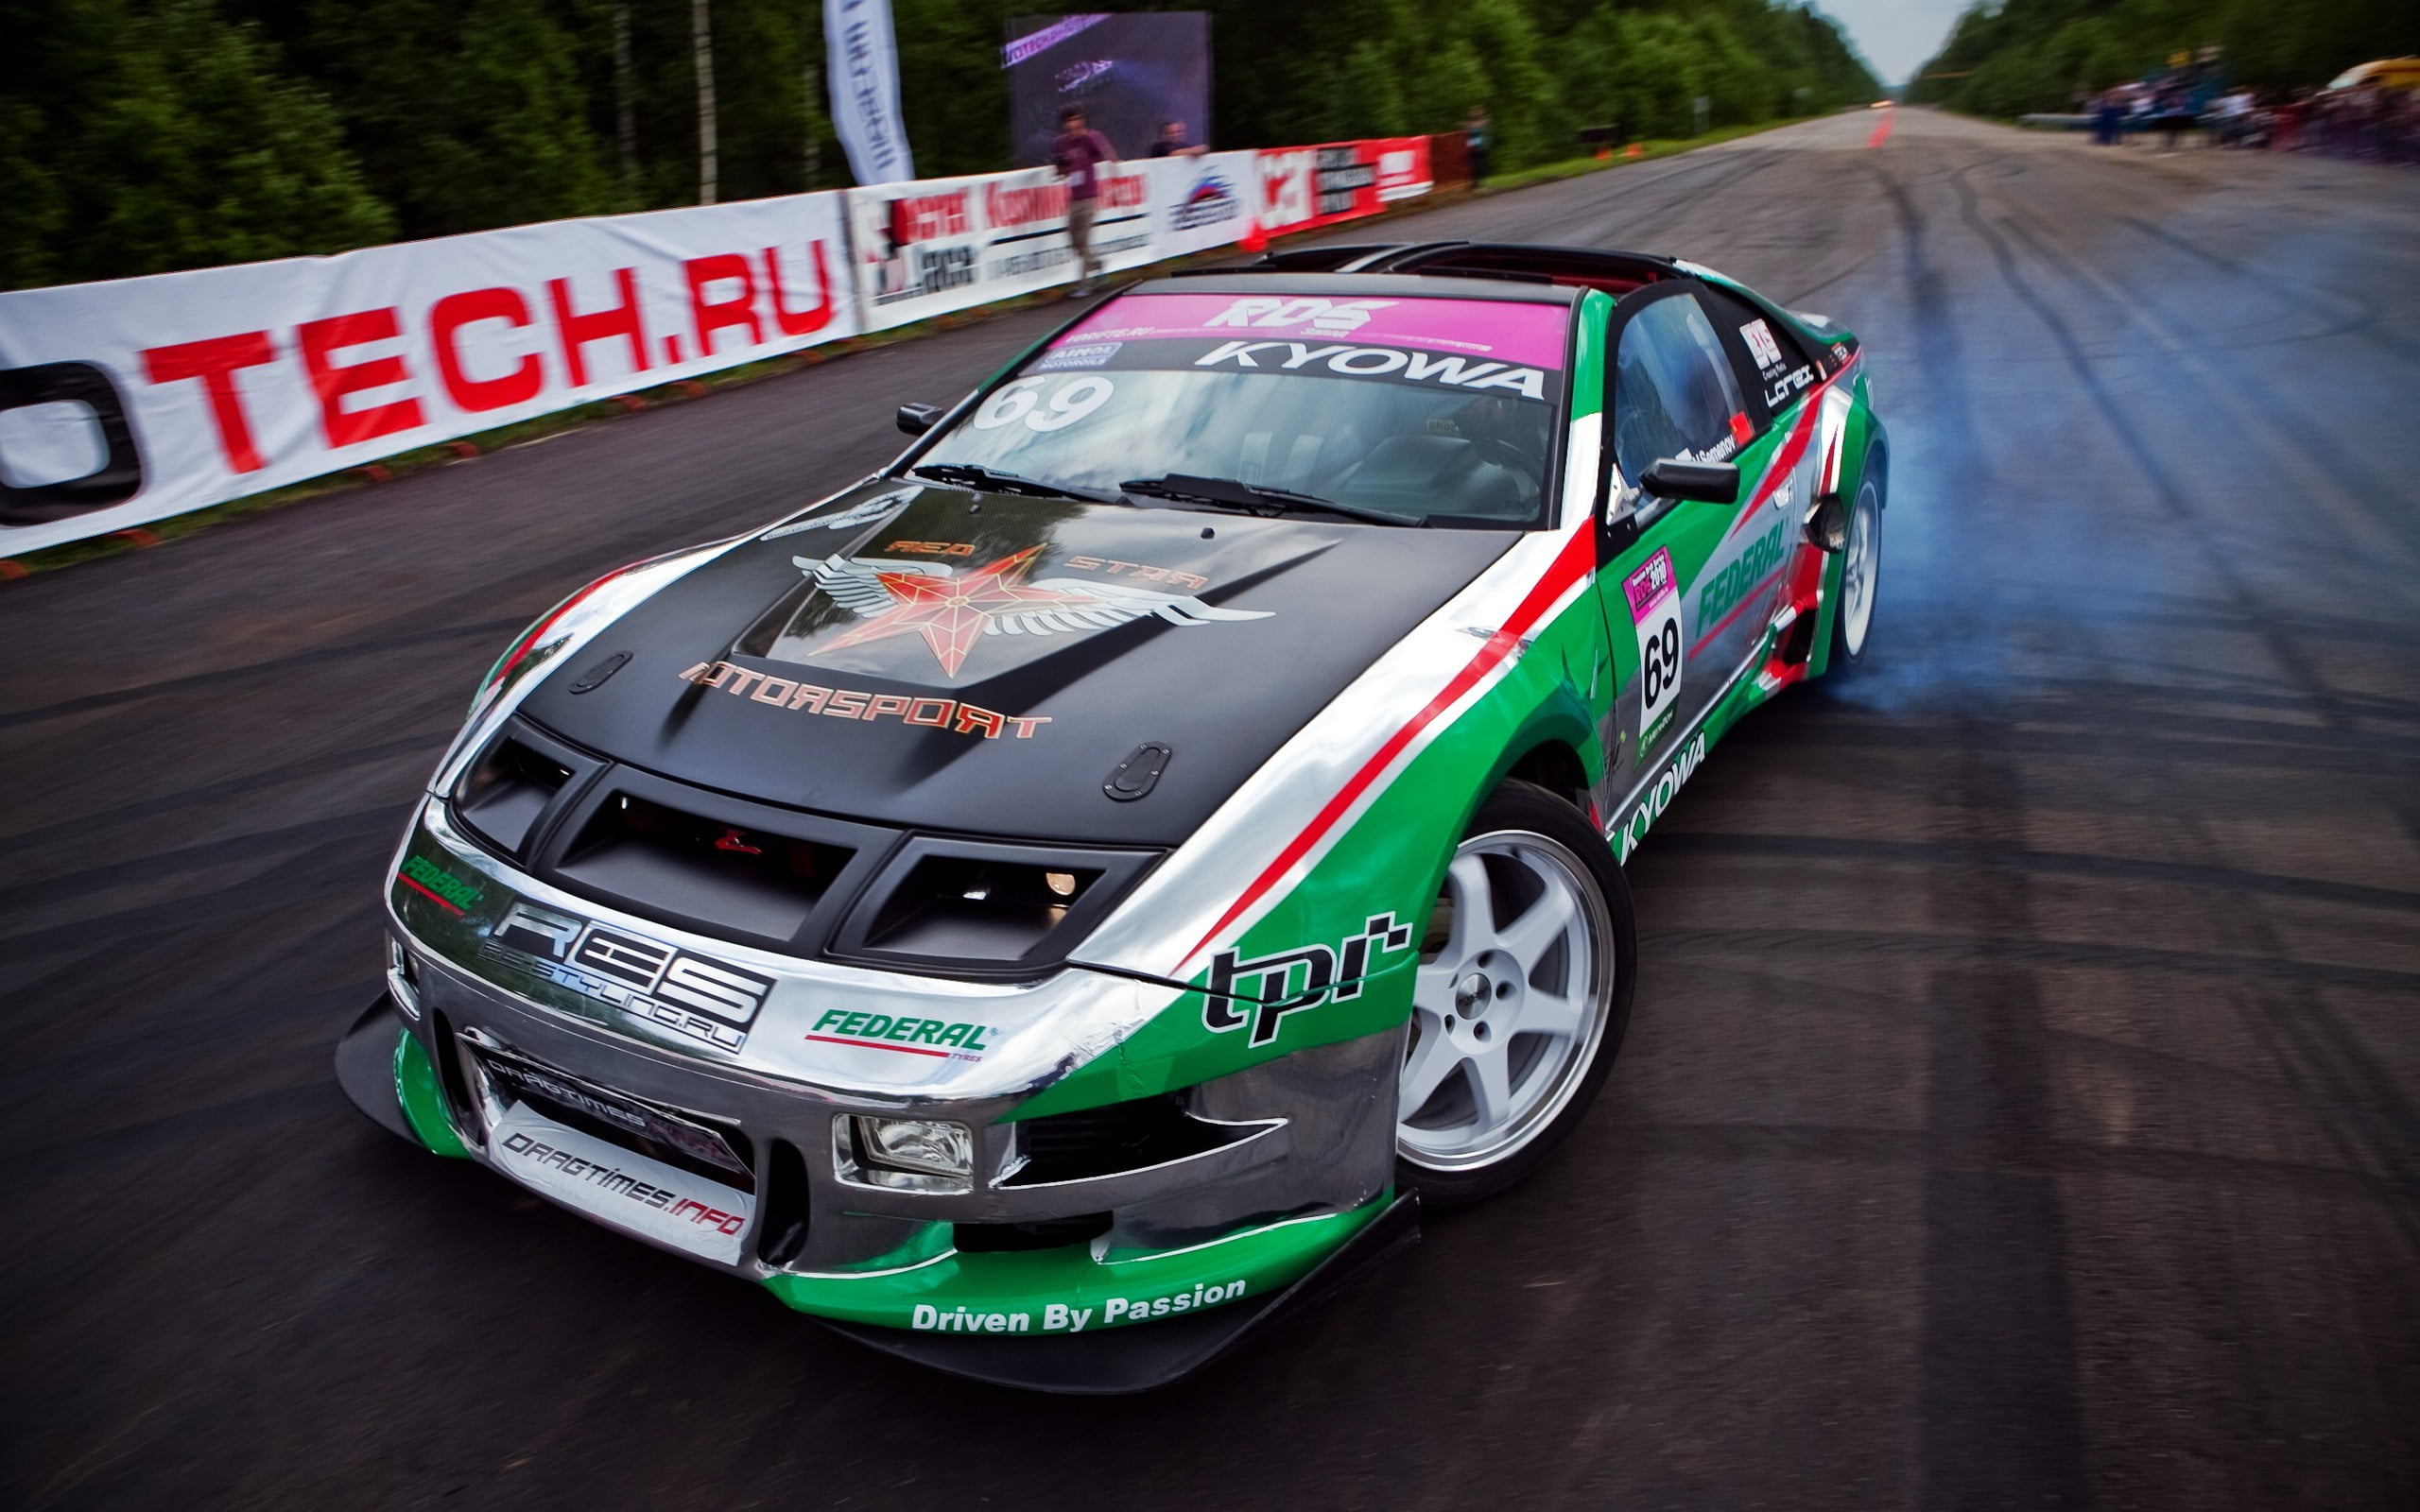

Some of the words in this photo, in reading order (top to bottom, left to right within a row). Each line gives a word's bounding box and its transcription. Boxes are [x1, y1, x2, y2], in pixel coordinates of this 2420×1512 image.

[1202, 298, 1400, 332] RDS
[1194, 341, 1545, 401] KYOWA
[973, 375, 1115, 433] 69
[1695, 520, 1787, 639] FEDERAL
[1643, 617, 1680, 710] 69
[1619, 731, 1706, 868] KYOWA
[401, 853, 475, 910] FEDERAL
[493, 900, 769, 1023] RES
[811, 1008, 991, 1052] FEDERAL
[951, 1052, 983, 1063] TYRES
[487, 1058, 647, 1128] DRAGTIMES
[501, 1132, 746, 1236] DRAGTIMES.INFO
[911, 1304, 1030, 1332] Driven
[1043, 1304, 1093, 1333] By
[1103, 1279, 1247, 1324] Passion
